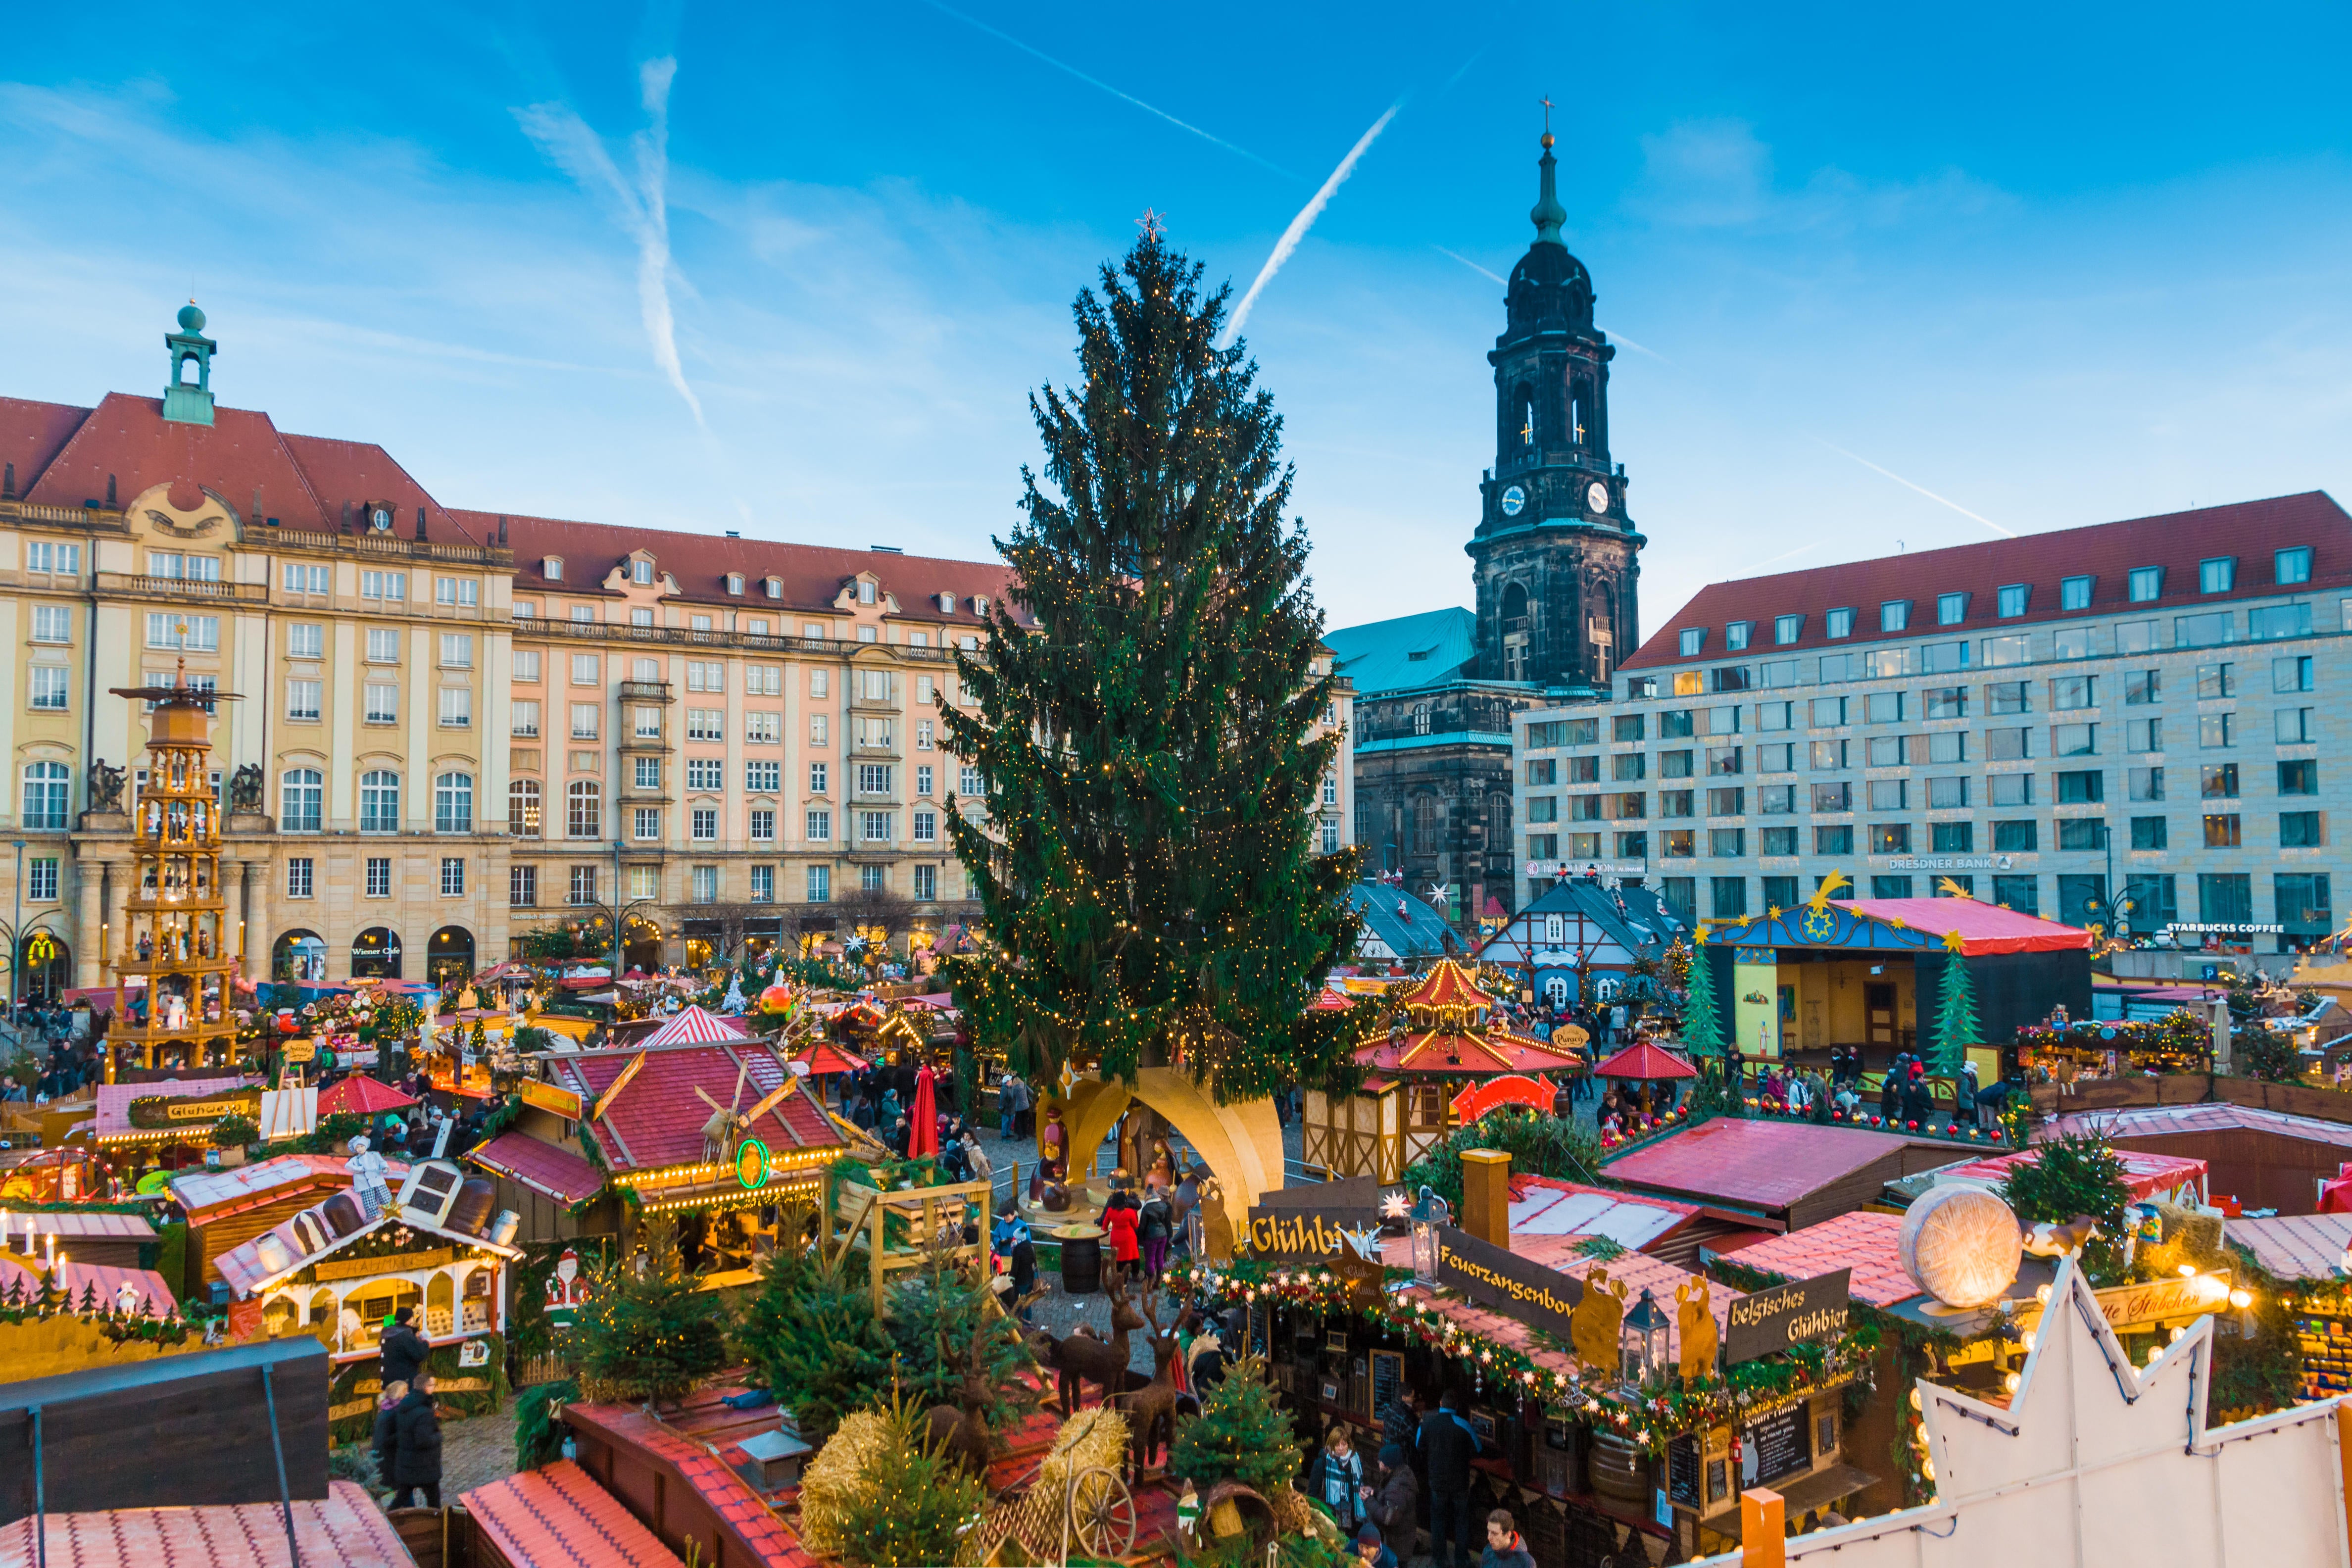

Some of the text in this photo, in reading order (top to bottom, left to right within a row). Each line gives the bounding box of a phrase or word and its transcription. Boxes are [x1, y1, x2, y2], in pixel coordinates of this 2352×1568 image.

[1556, 864, 1615, 873] COLLEION
[1889, 858, 1992, 869] DRESDNER BANK
[2166, 923, 2284, 933] STARBUCKS COFFEE
[2206, 969, 2214, 980] P
[1251, 1214, 1365, 1255] Glühbi
[1731, 1288, 1805, 1326] belgisches
[2128, 1288, 2200, 1322] Stübchen
[1788, 1308, 1848, 1342] Glühbier
